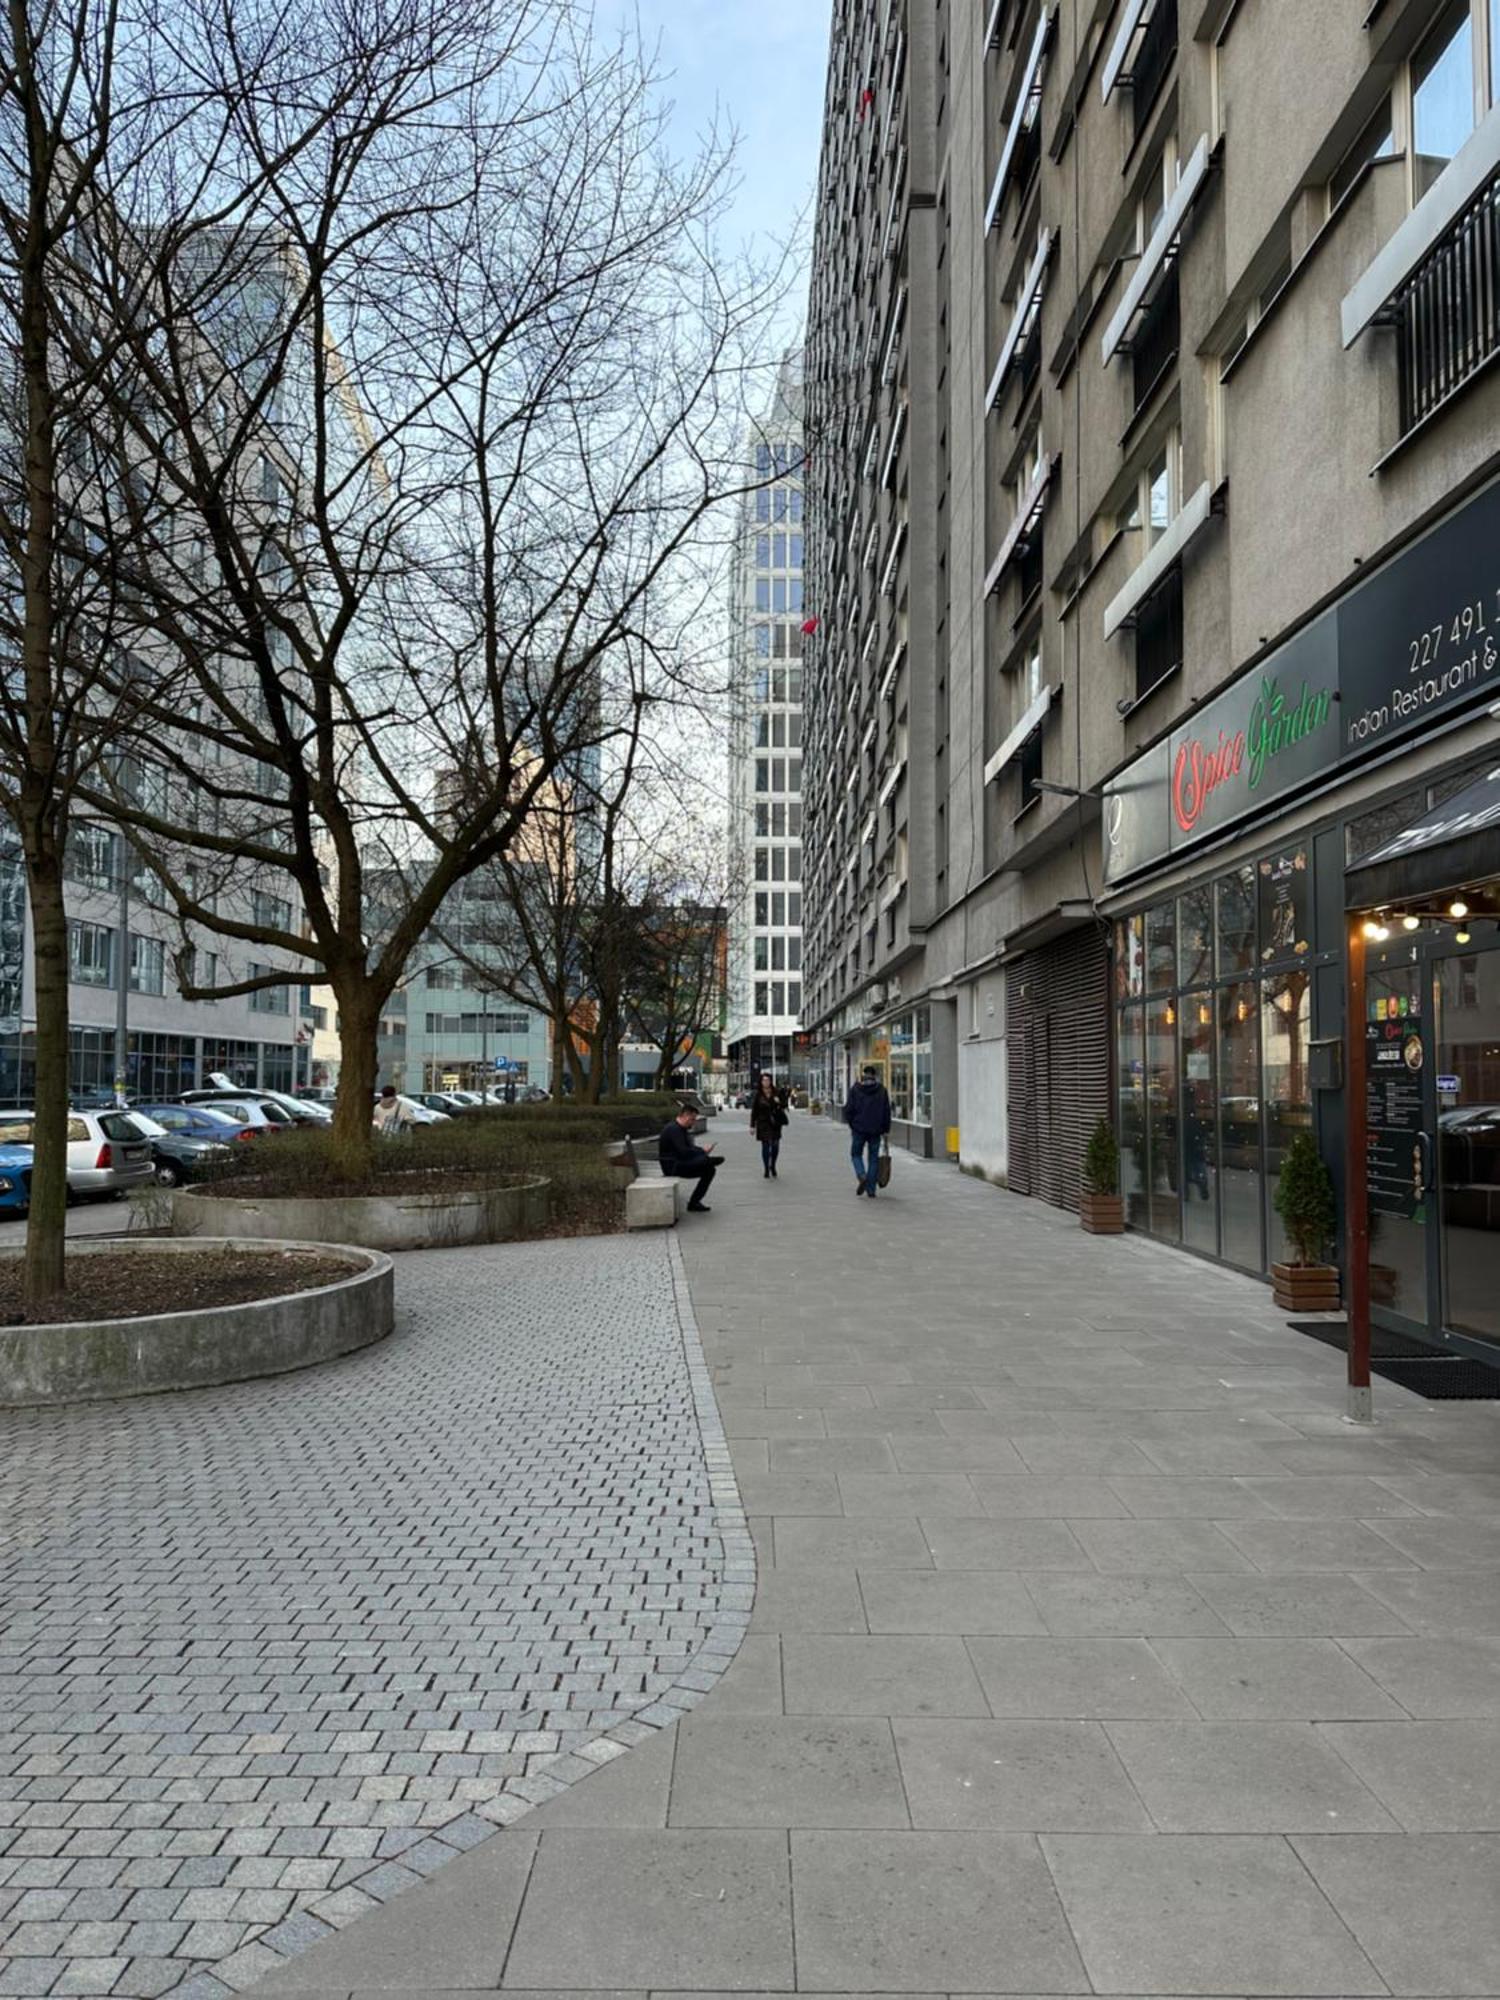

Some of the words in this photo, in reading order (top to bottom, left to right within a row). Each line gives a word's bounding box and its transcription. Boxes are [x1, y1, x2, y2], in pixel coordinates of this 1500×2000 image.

[1347, 706, 1389, 744] Indian
[1392, 649, 1478, 721] Restaurant
[1482, 635, 1498, 671] &
[1409, 624, 1443, 673] 227
[1450, 600, 1486, 646] 491
[1172, 729, 1245, 832] Spice
[1247, 680, 1330, 790] Garden
